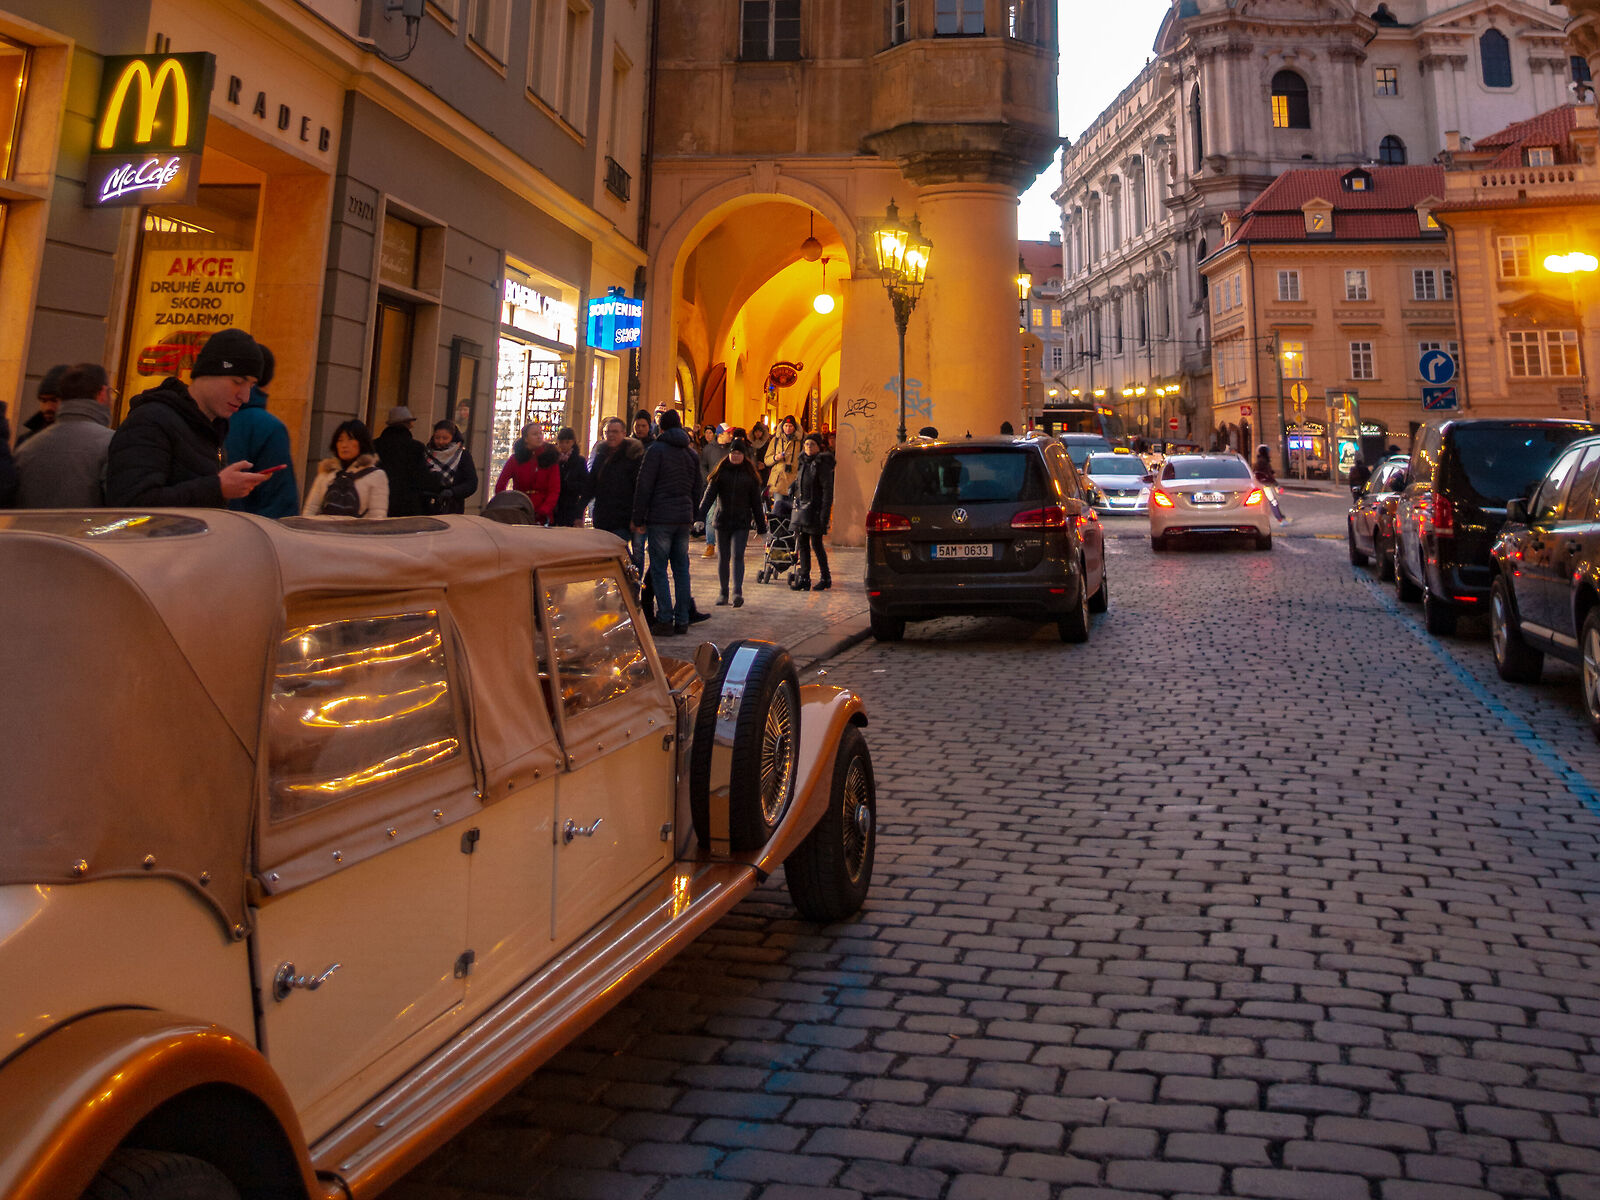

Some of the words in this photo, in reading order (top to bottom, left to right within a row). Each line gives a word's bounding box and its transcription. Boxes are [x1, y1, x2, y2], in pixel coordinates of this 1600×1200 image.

[213, 63, 331, 152] RADEB
[103, 157, 180, 198] McCafé
[168, 257, 234, 277] AKCE
[150, 278, 201, 294] DRUHÉ
[203, 281, 246, 294] AUTO
[170, 297, 222, 310] SKORO
[588, 301, 643, 318] SOUVENIRS
[155, 313, 234, 326] ZADARMO!
[615, 327, 641, 343] SHOP
[939, 545, 957, 556] 5AM
[964, 545, 989, 556] 0633
